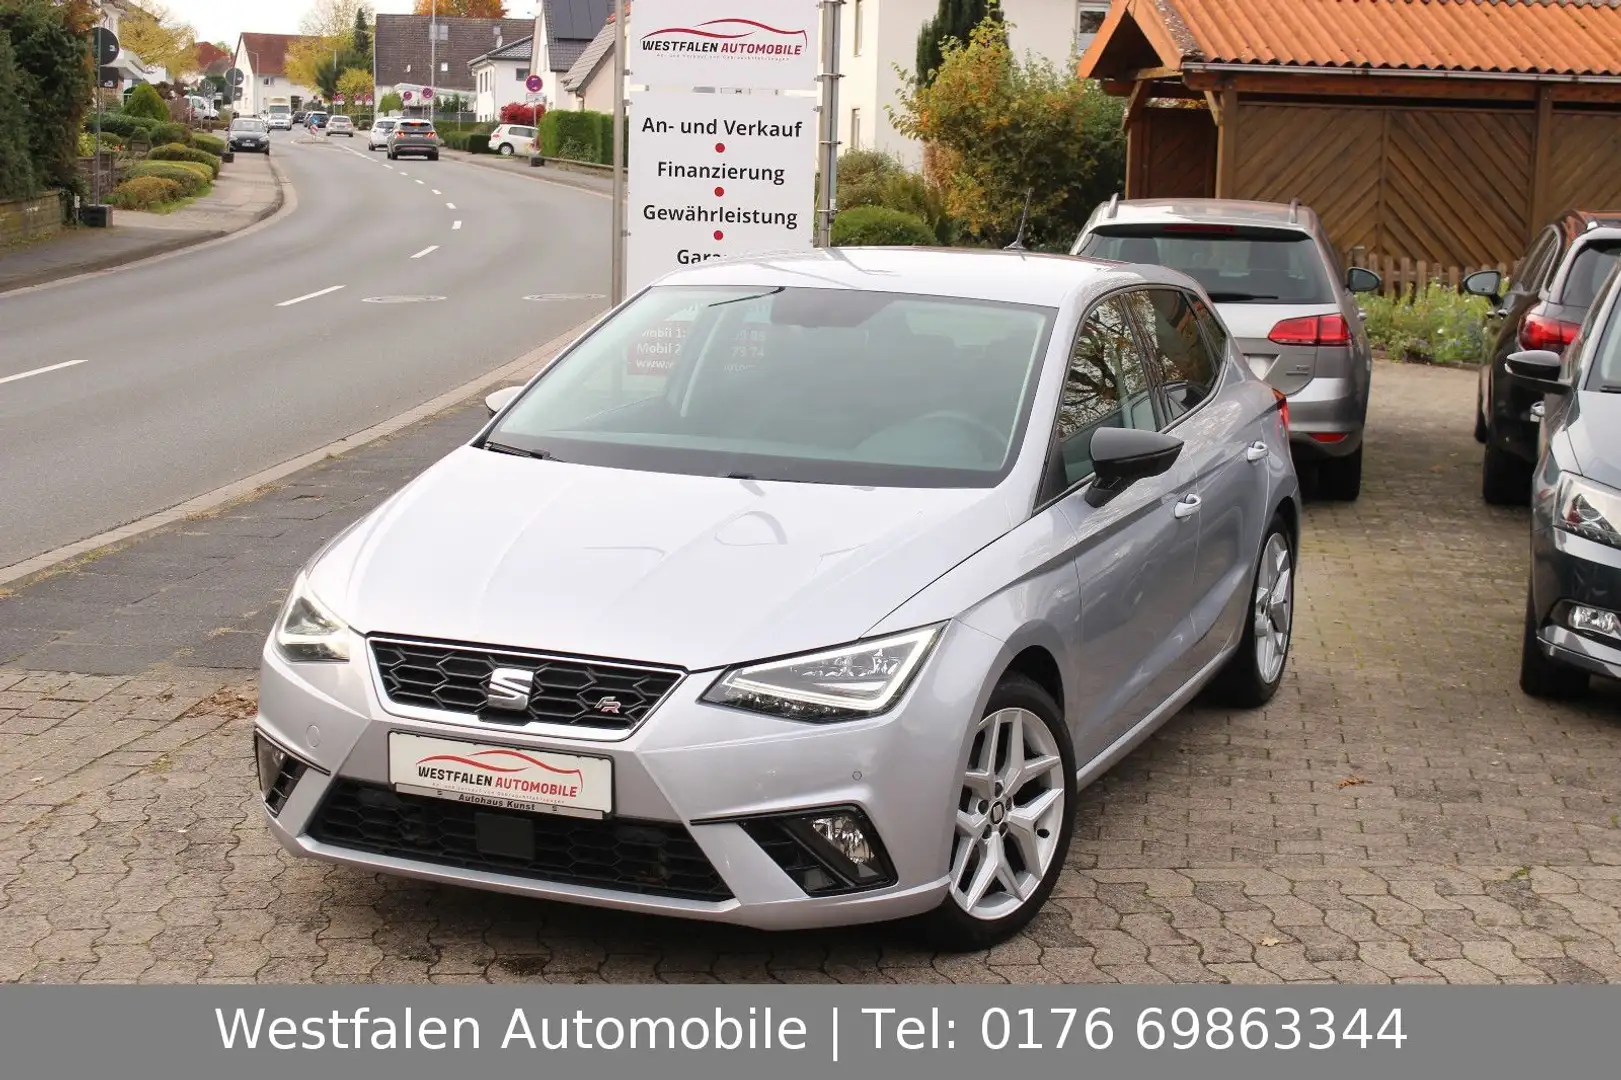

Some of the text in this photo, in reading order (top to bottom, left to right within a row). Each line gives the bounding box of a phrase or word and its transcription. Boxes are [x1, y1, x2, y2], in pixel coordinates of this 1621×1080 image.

[642, 40, 802, 56] WESTFALEN AUTOMOBILE
[641, 117, 803, 138] An- und Verkauf
[657, 161, 785, 186] Finanzierung
[642, 204, 798, 230] Gewährleistung
[418, 766, 578, 798] WESTFALEN AUTOMOBILE
[458, 793, 536, 812] Autohaus Kunst
